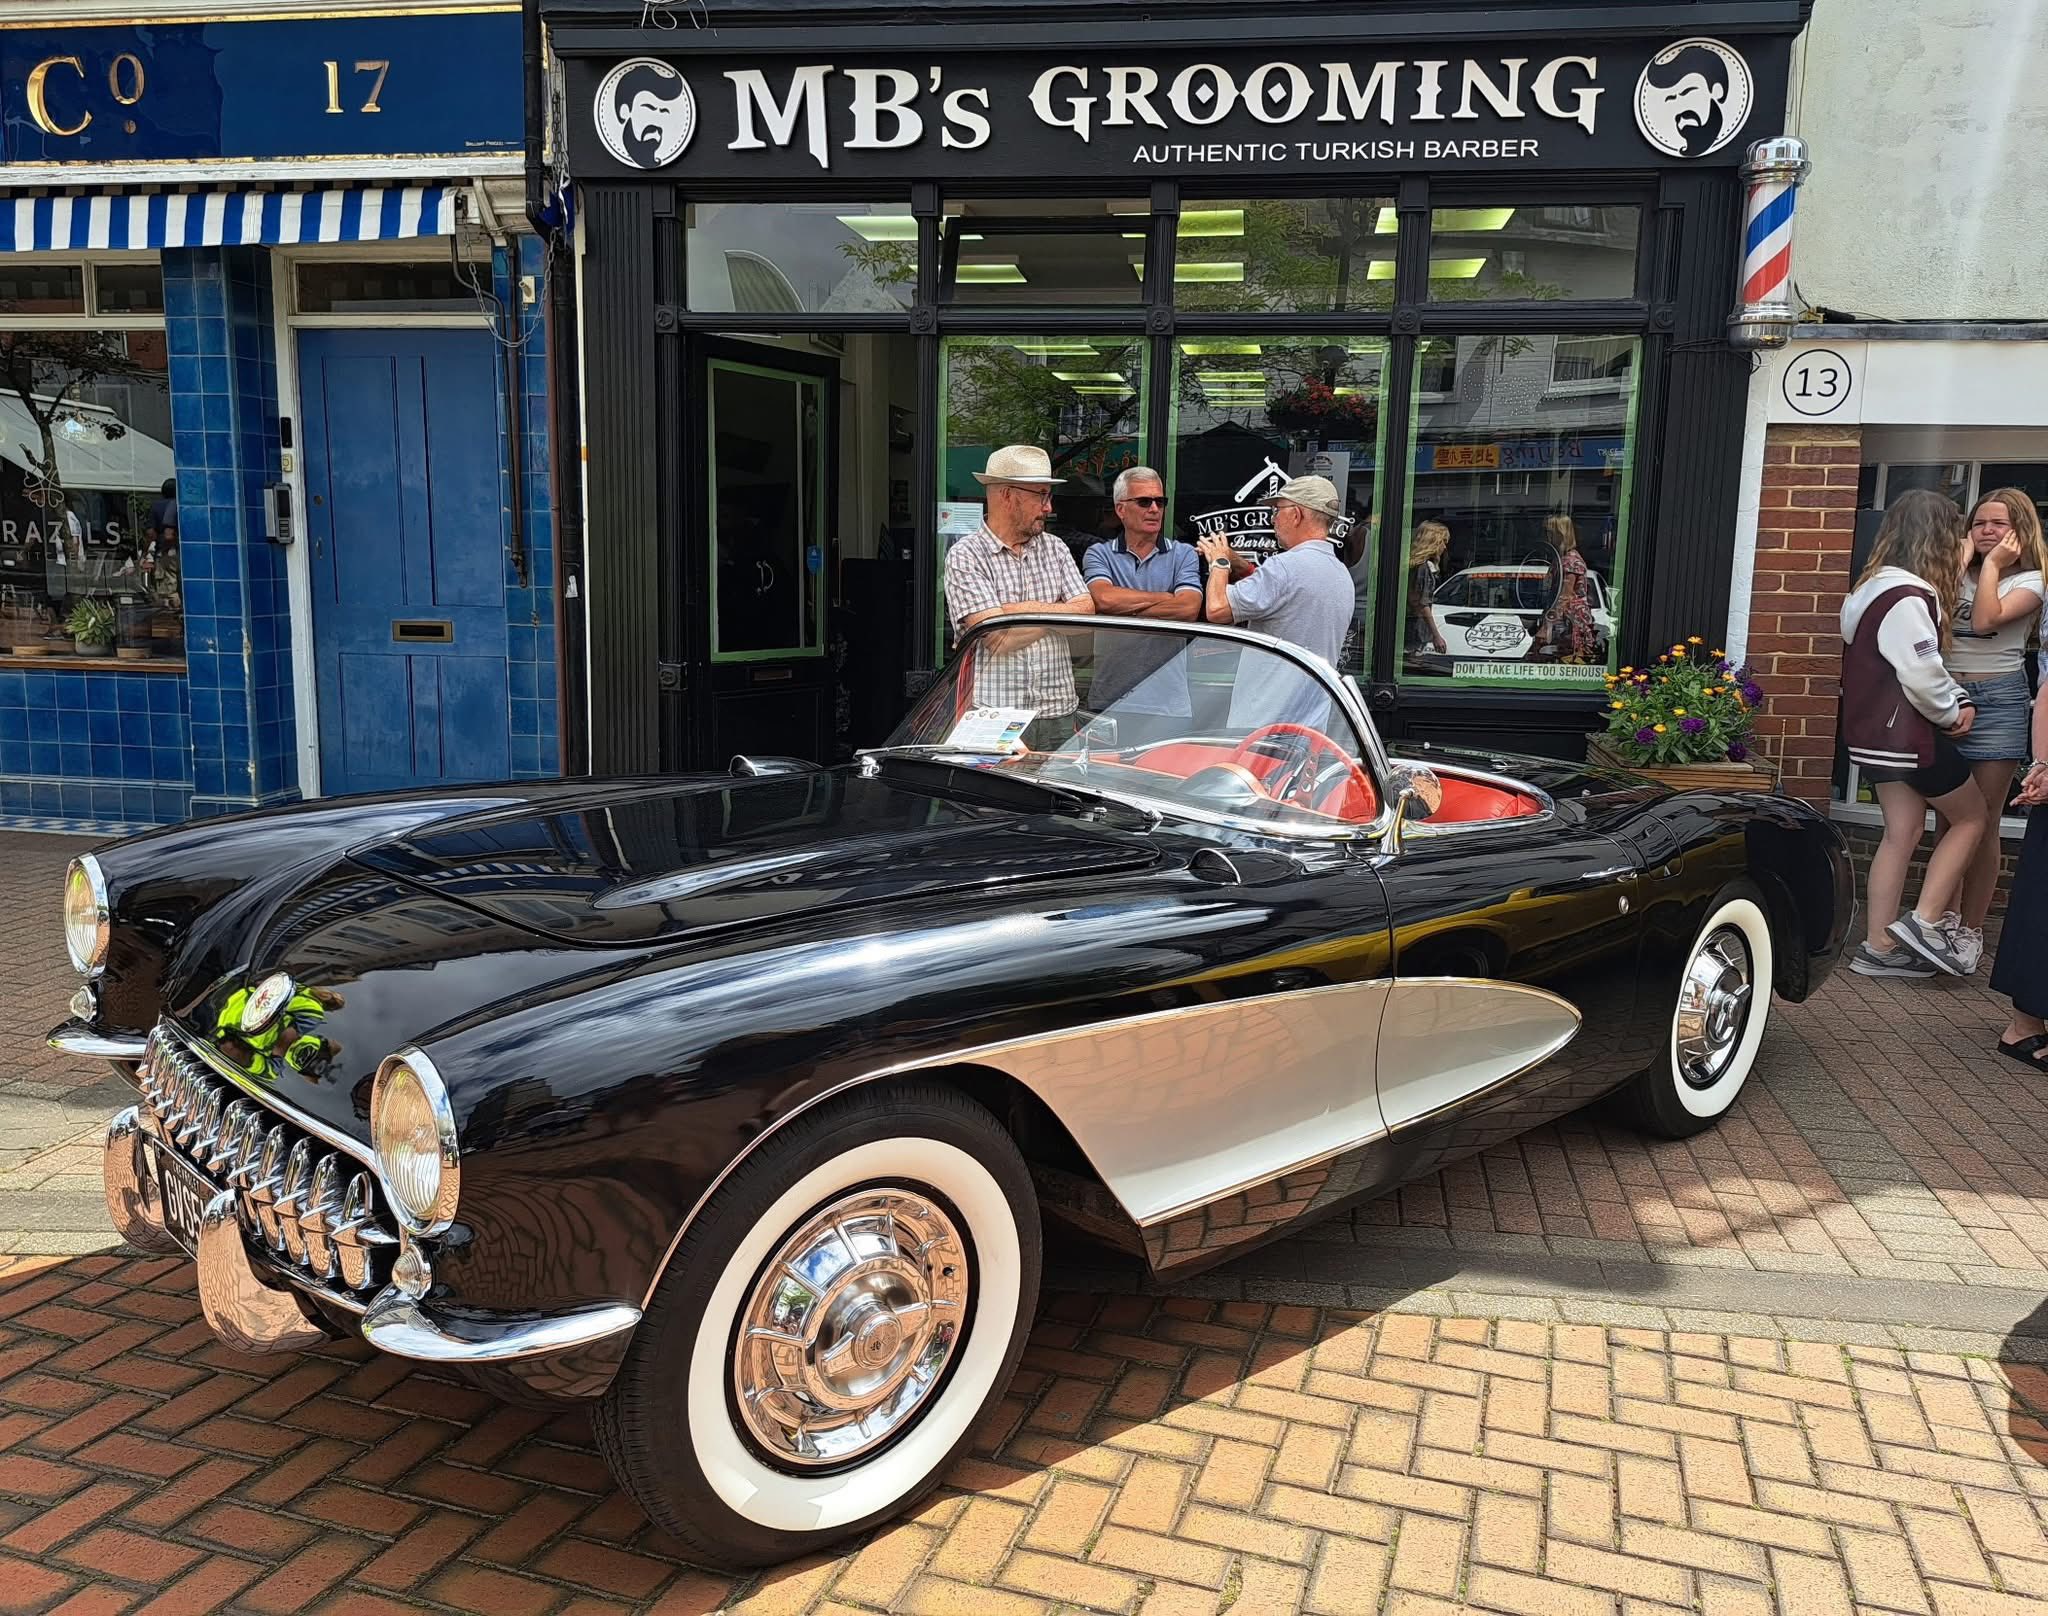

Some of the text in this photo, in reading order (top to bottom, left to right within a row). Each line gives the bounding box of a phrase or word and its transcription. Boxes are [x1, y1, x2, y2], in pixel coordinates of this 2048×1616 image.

[323, 60, 390, 113] 17
[1028, 55, 1605, 143] GROOMING
[1133, 138, 1540, 163] AUTHENTIC TURKISH BARBER
[1795, 367, 1838, 397] 13
[2, 519, 121, 545] RAZLS
[1197, 511, 1240, 535] MB'S
[1455, 663, 1484, 674] DON'T
[1486, 664, 1511, 675] TAKE
[1514, 665, 1534, 676] LIFE
[1537, 665, 1556, 677] TOO
